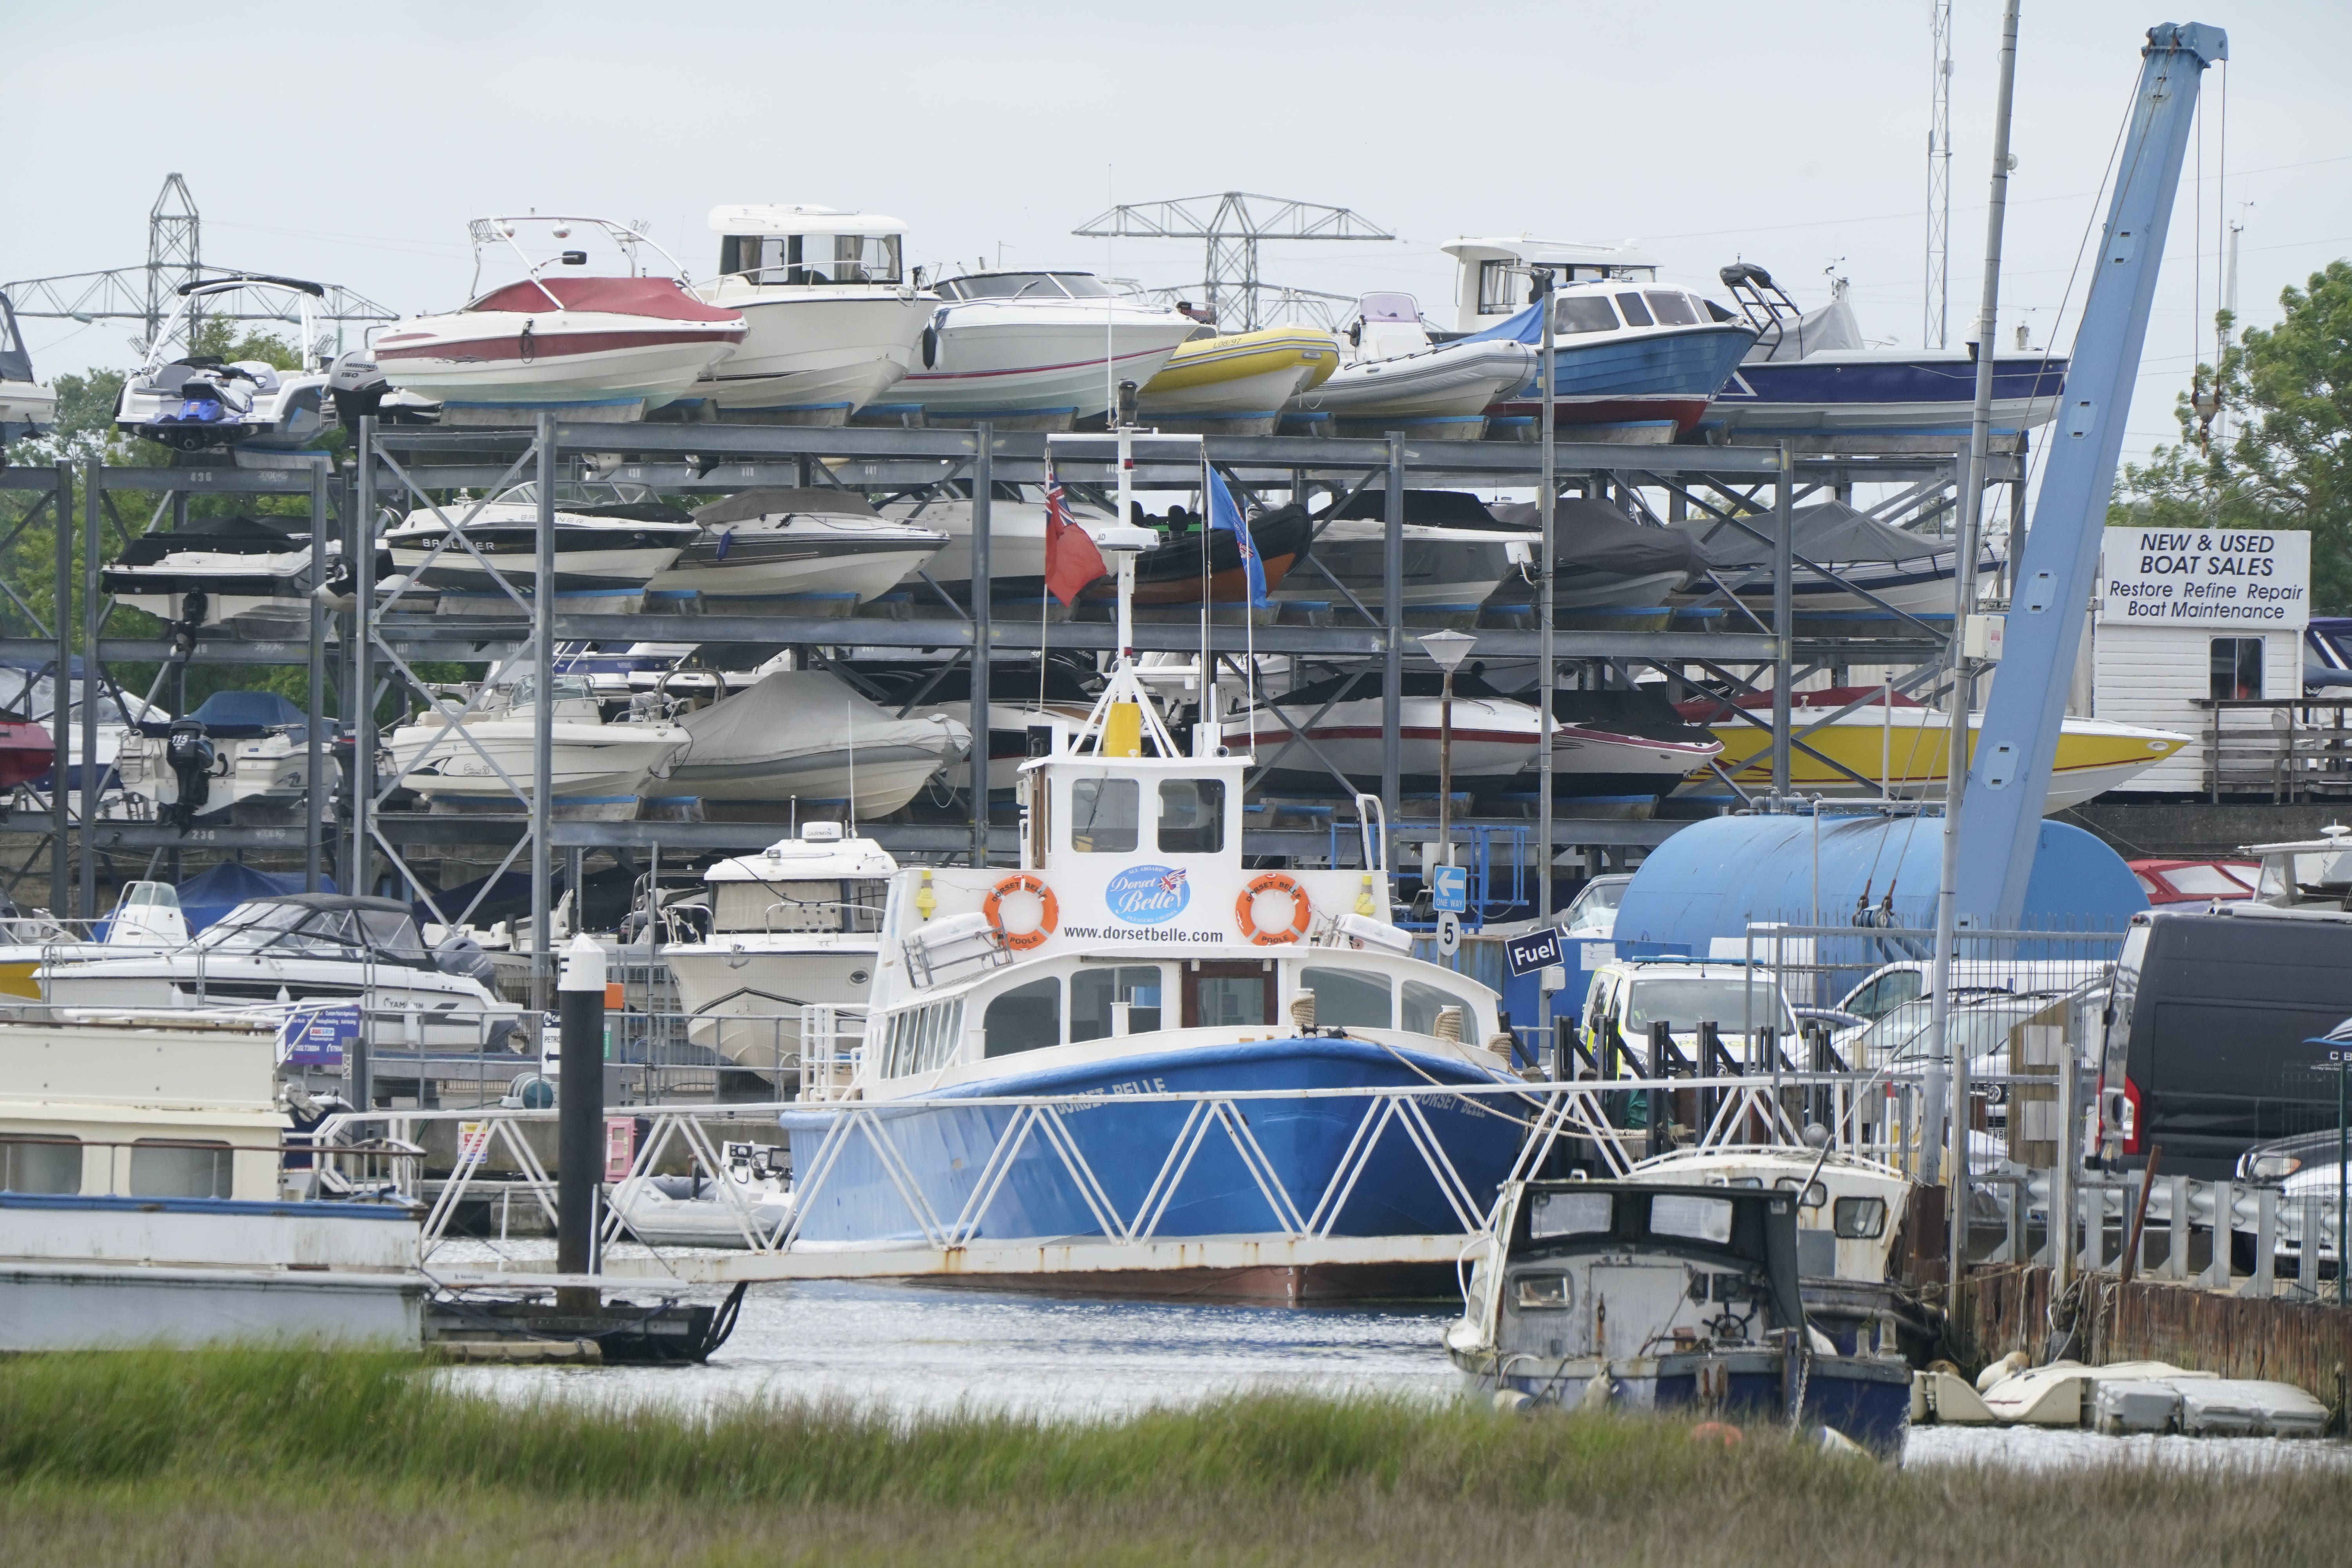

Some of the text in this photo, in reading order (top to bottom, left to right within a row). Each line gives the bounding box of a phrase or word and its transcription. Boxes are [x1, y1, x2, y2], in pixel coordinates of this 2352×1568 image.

[1213, 338, 1242, 348] L08/97
[521, 514, 584, 524] BANER
[2140, 534, 2275, 552] NEW & USED
[2140, 555, 2274, 576] BOAT SALES
[2110, 581, 2303, 602] Restore Refine Repair
[2128, 601, 2285, 619] Boat Maintenance
[172, 735, 189, 744] 115
[992, 882, 1048, 902] DORSET BELLE
[1110, 877, 1156, 892] Dorset
[1246, 881, 1301, 902] DORSET BELLE
[1115, 888, 1175, 915] Belle
[1450, 899, 1463, 907] WAY
[1156, 910, 1178, 922] CRUISES
[1009, 936, 1038, 945] POOLE
[1064, 926, 1223, 942] www.dorsetbelle.com
[1261, 935, 1289, 944] POOLE
[1444, 922, 1454, 945] 5
[1514, 938, 1555, 966] Fuel
[389, 1000, 424, 1009] YAMIN
[1412, 1093, 1458, 1110] DORSET
